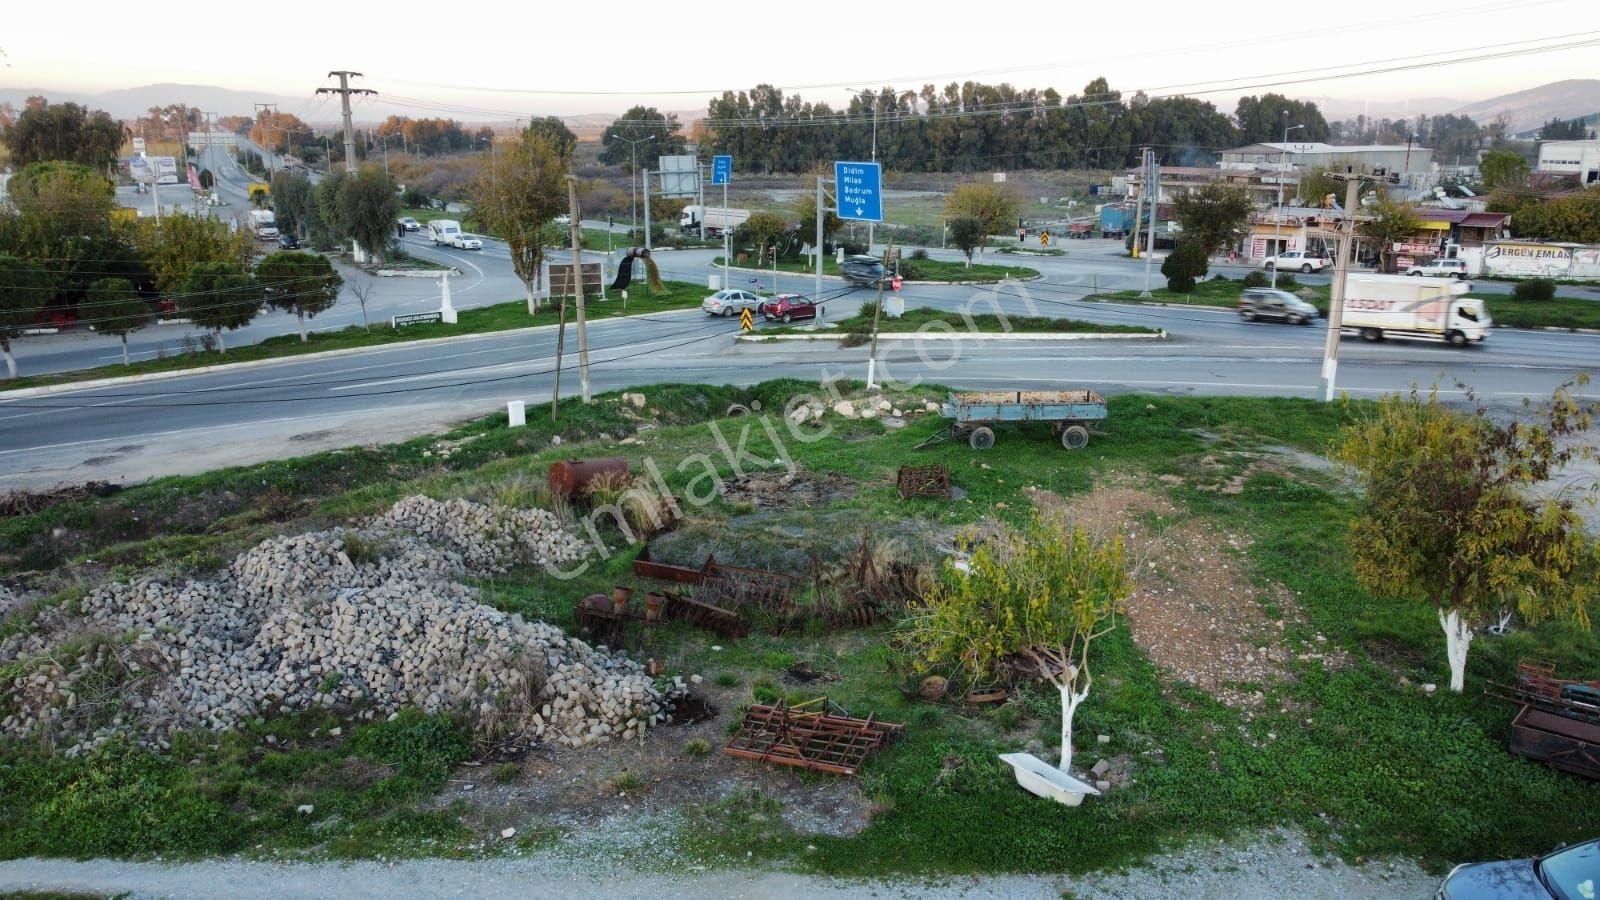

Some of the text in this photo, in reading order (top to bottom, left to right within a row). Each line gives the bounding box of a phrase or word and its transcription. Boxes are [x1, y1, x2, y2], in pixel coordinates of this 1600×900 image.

[843, 166, 864, 175] Didim
[843, 176, 862, 184] Milas
[844, 186, 873, 195] Bodrum
